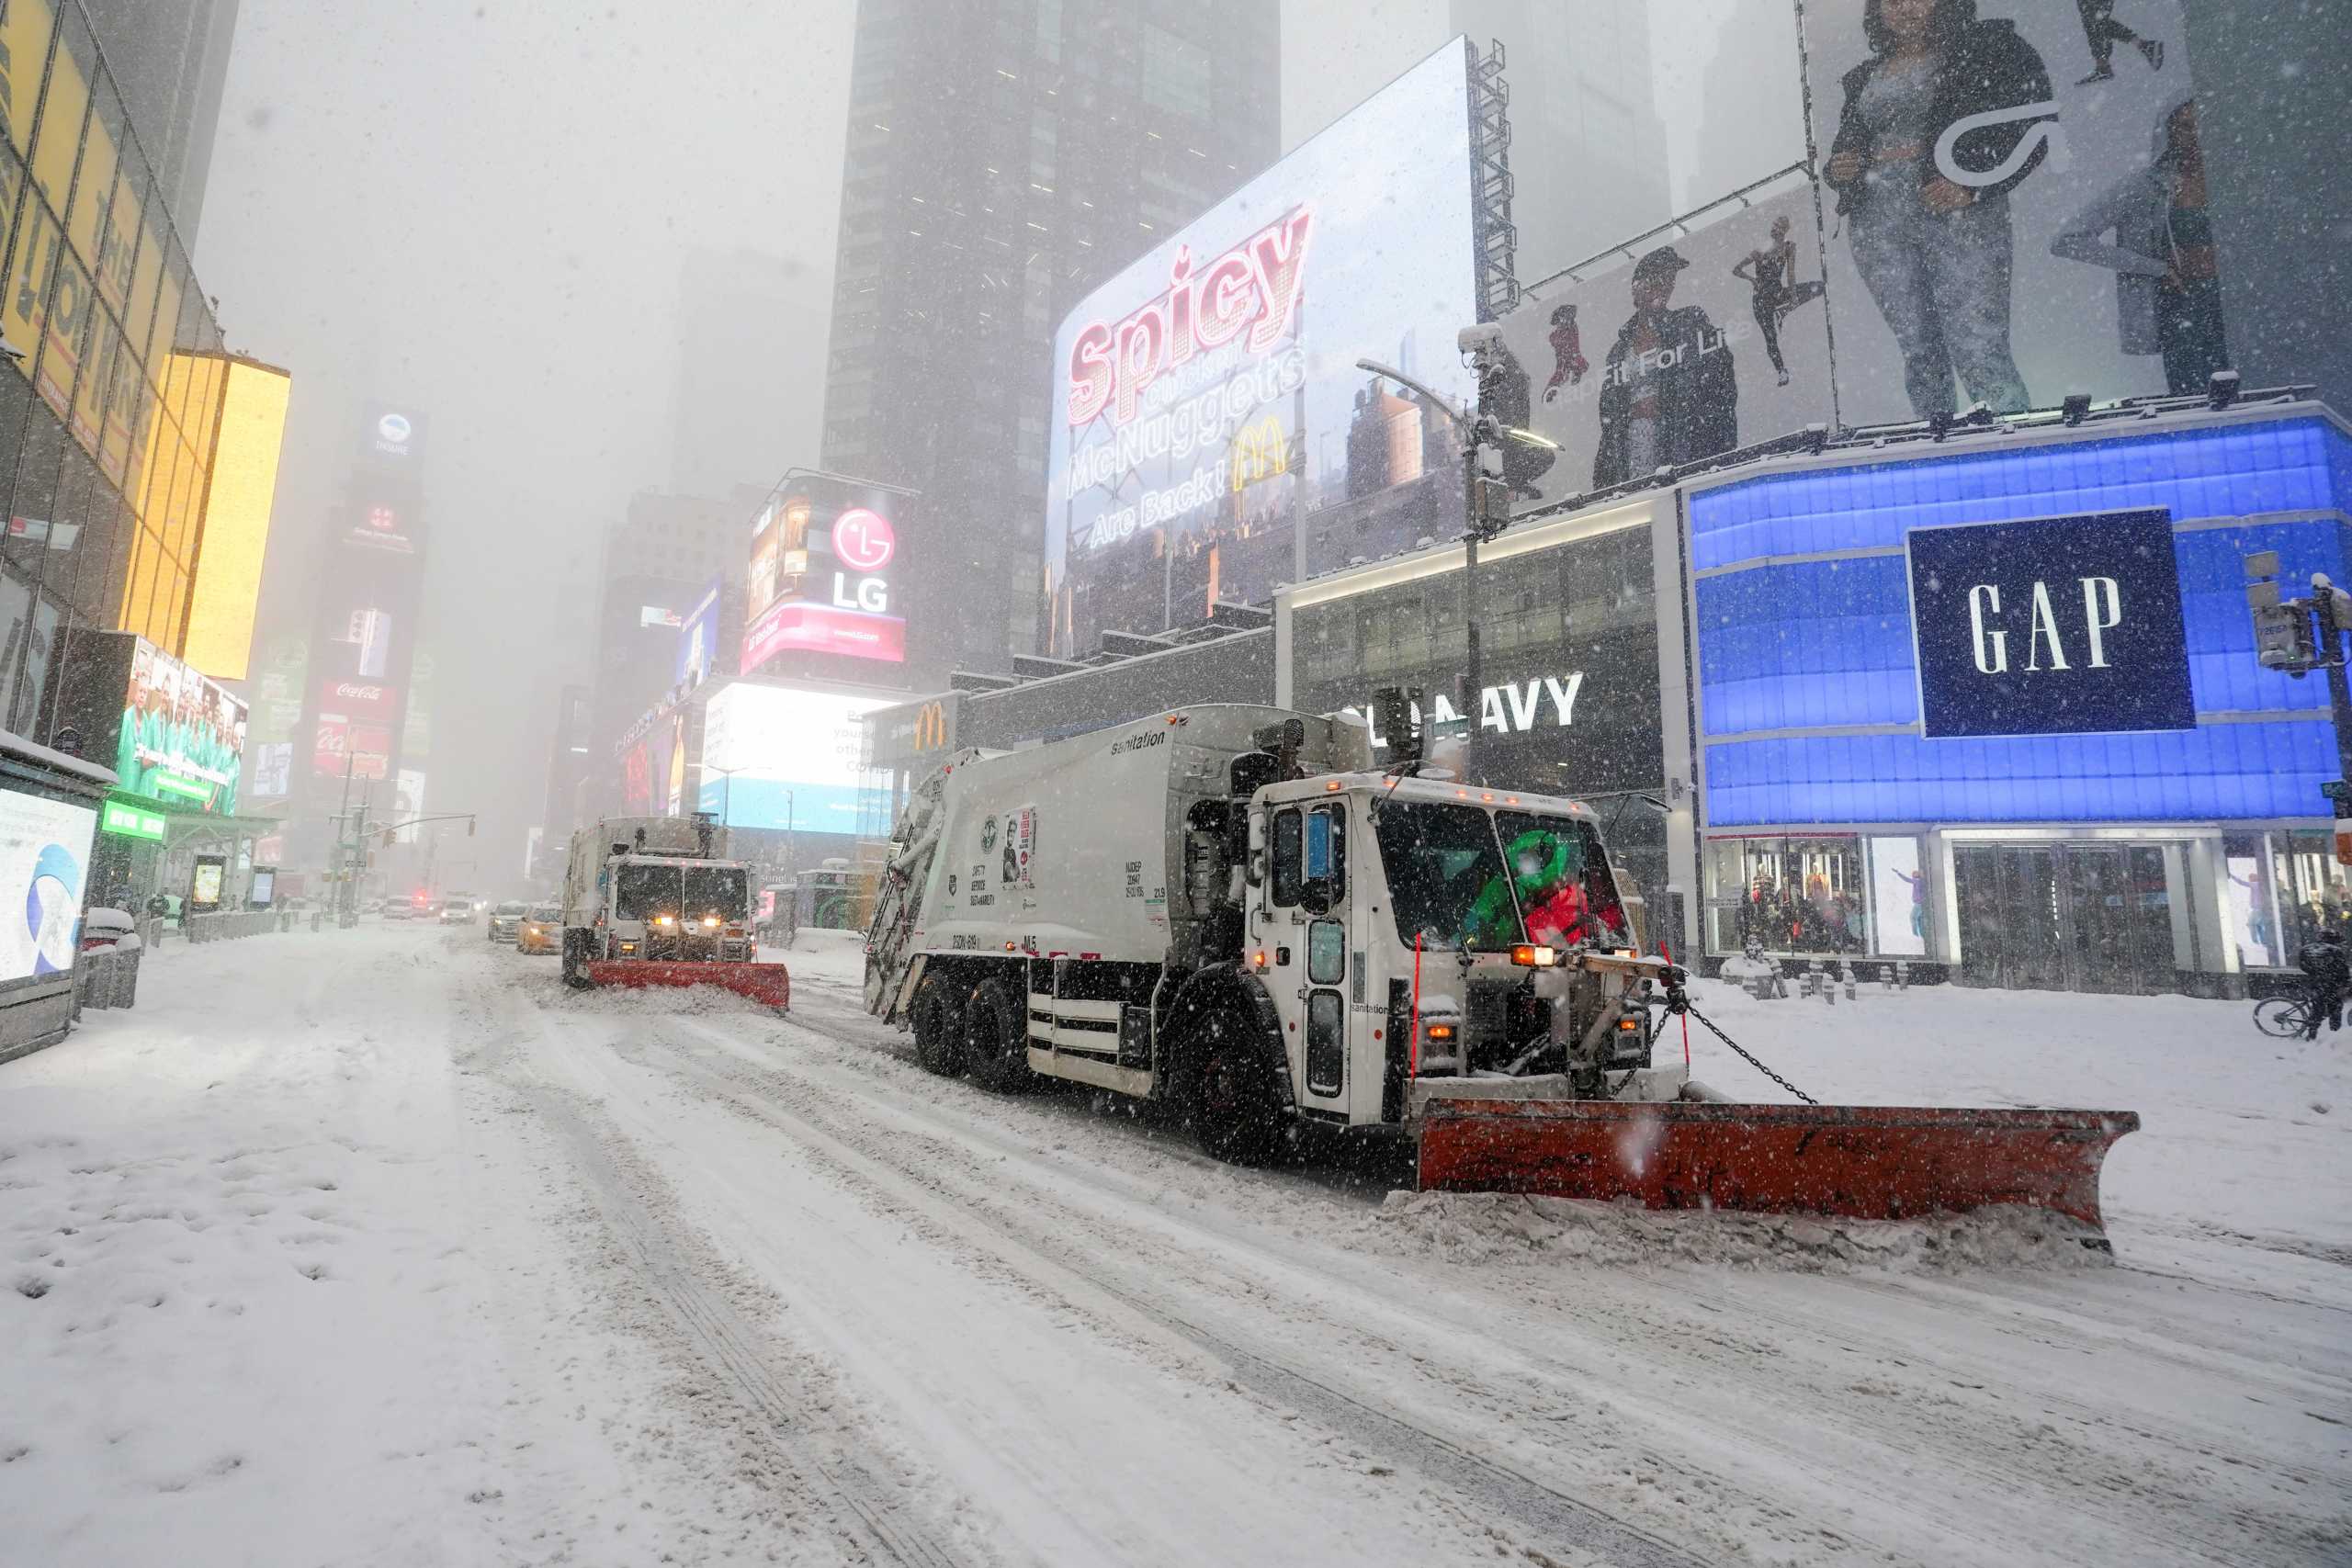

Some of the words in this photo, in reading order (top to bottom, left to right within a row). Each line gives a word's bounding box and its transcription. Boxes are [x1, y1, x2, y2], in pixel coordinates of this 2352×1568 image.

[1069, 199, 1315, 428] Spicy
[1639, 343, 1687, 376] For
[1090, 508, 1137, 550] Are
[1141, 459, 1227, 529] Back!
[832, 571, 888, 613] LG
[1969, 576, 2121, 675] GAP
[1435, 672, 1584, 740] NAVY
[1111, 730, 1165, 758] sanitation
[1351, 1003, 1388, 1015] sanitation
